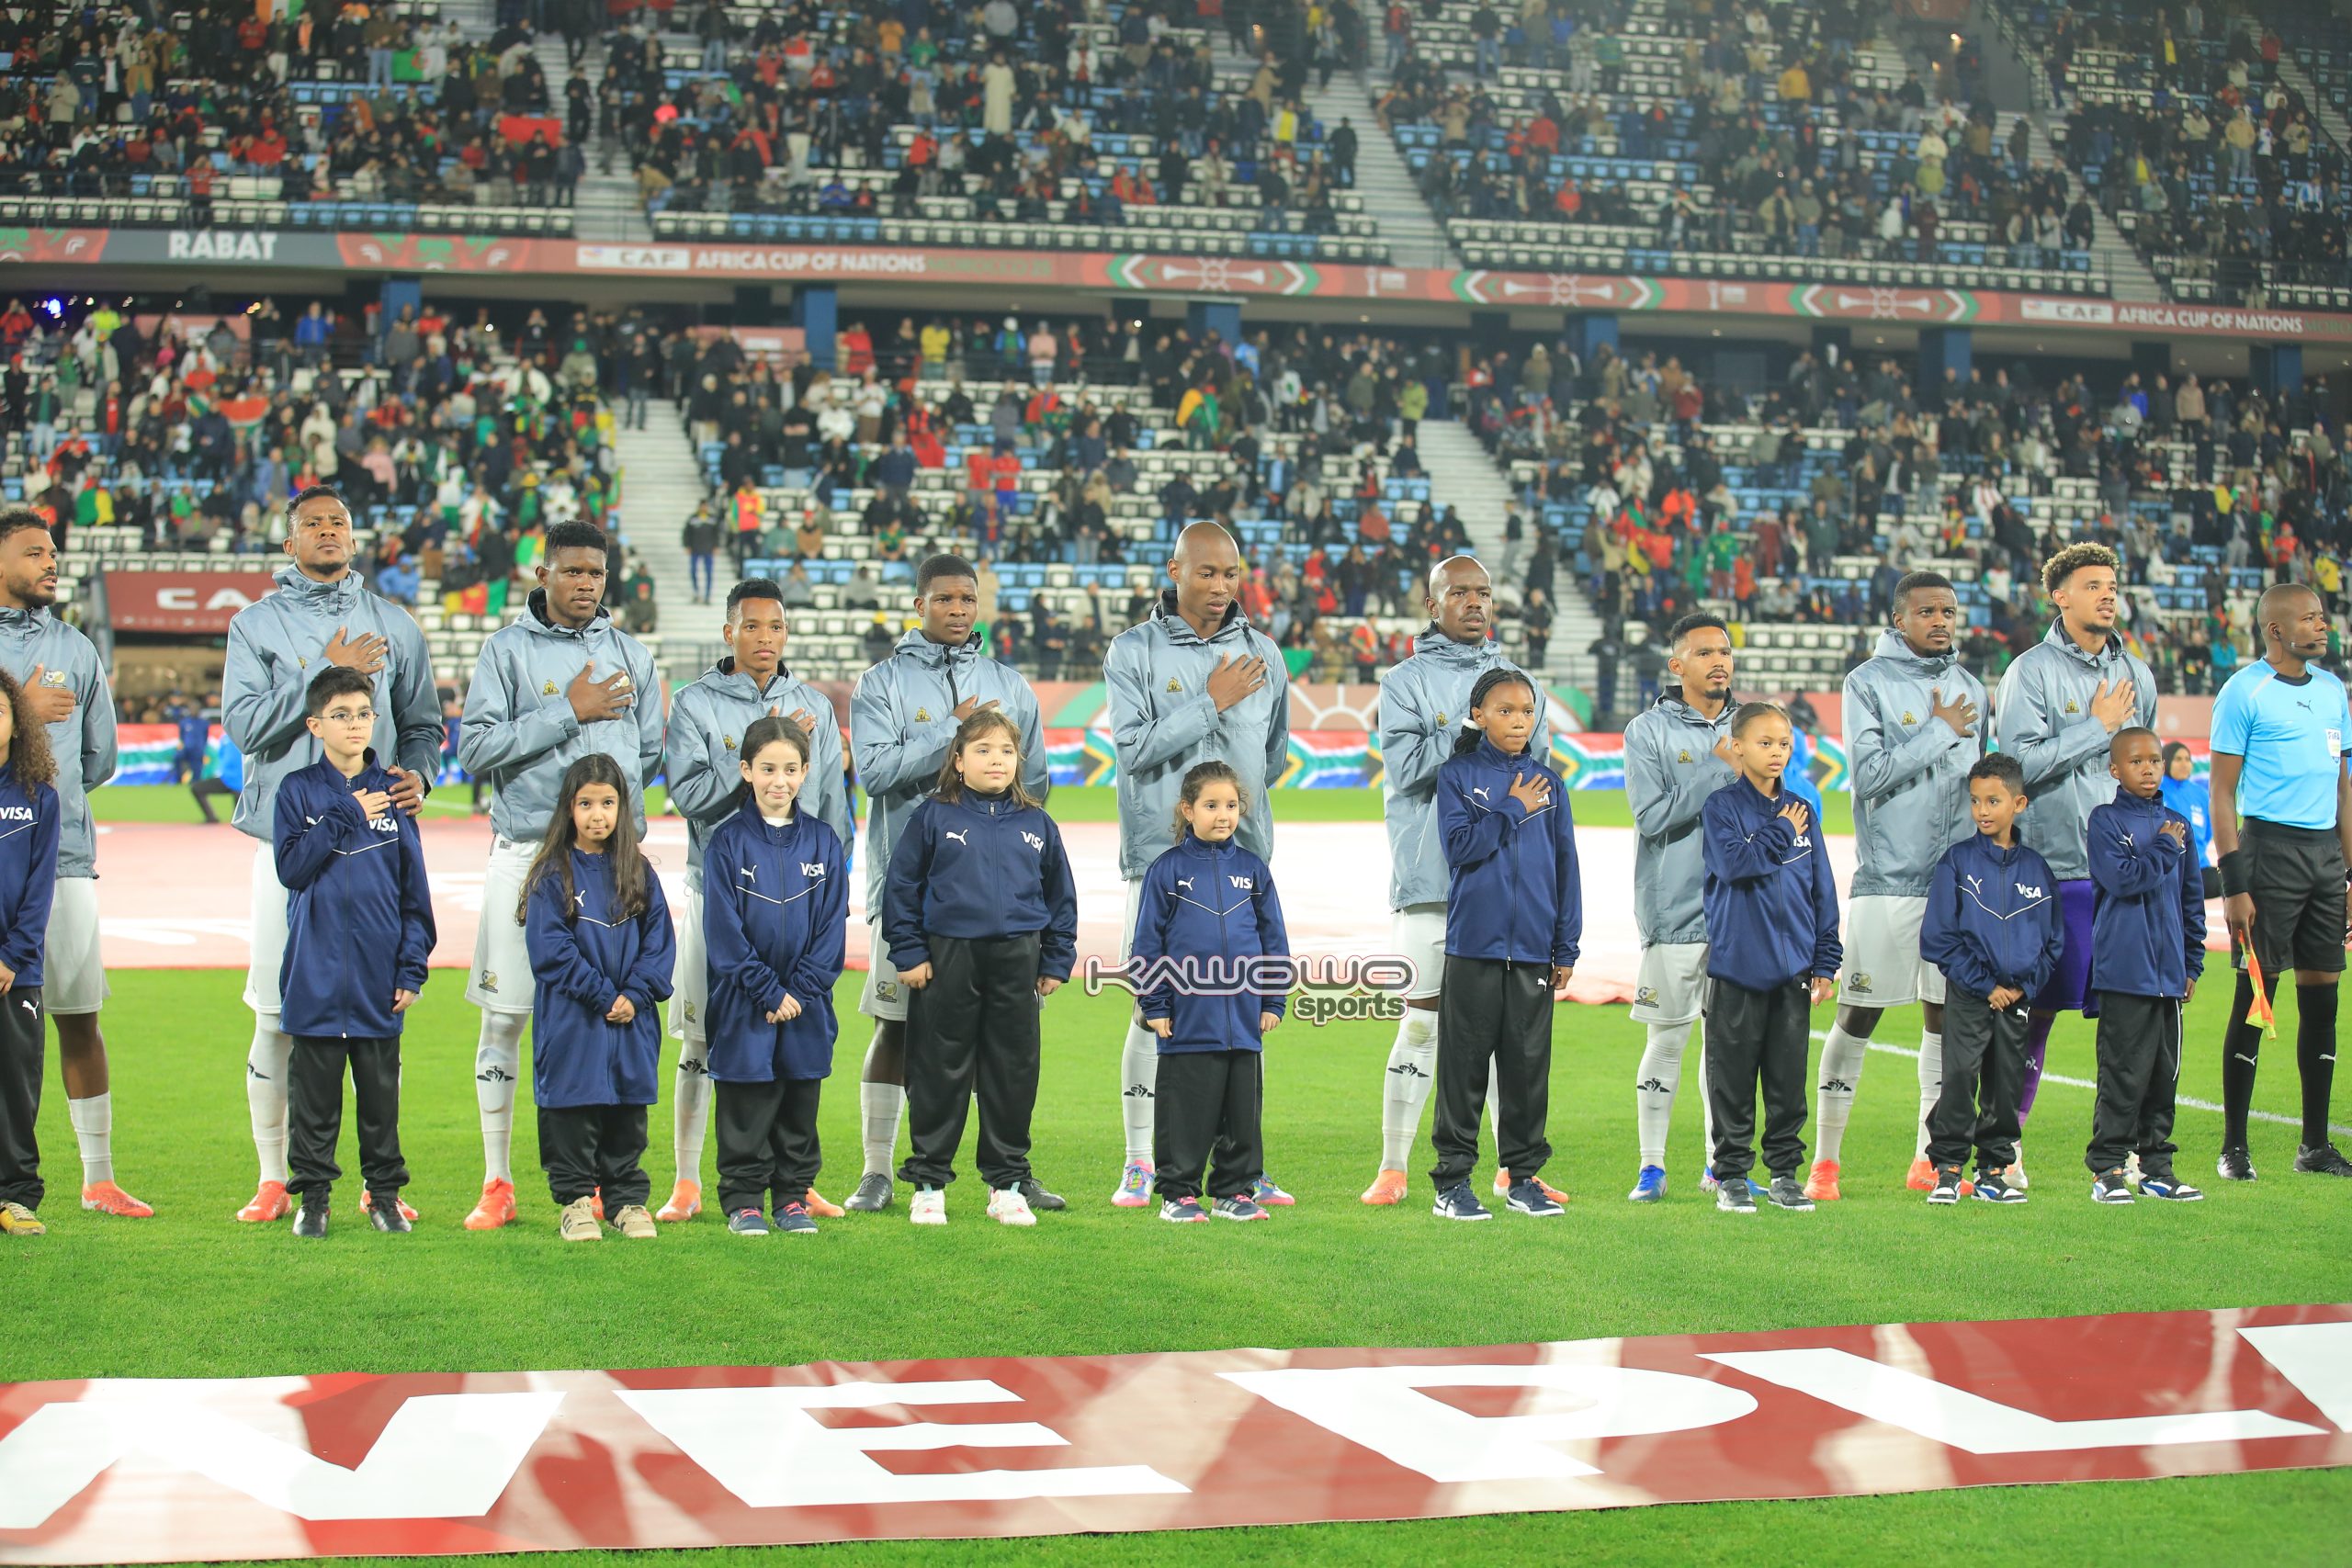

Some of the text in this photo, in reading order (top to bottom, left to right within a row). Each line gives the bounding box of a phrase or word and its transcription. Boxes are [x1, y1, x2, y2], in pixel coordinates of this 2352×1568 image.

[168, 231, 277, 260] RABAT
[620, 252, 675, 265] CAF
[695, 250, 766, 269] AFRICA
[769, 251, 808, 271] CUP
[811, 252, 837, 271] OF
[841, 253, 926, 273] NATIONS
[2056, 305, 2102, 319] CAF
[2118, 306, 2175, 325] AFRICA
[2177, 310, 2209, 328] CUP
[2211, 312, 2233, 330] OF
[2235, 313, 2302, 333] NATIONS
[0, 807, 33, 820] VISA
[799, 862, 825, 877] VISA
